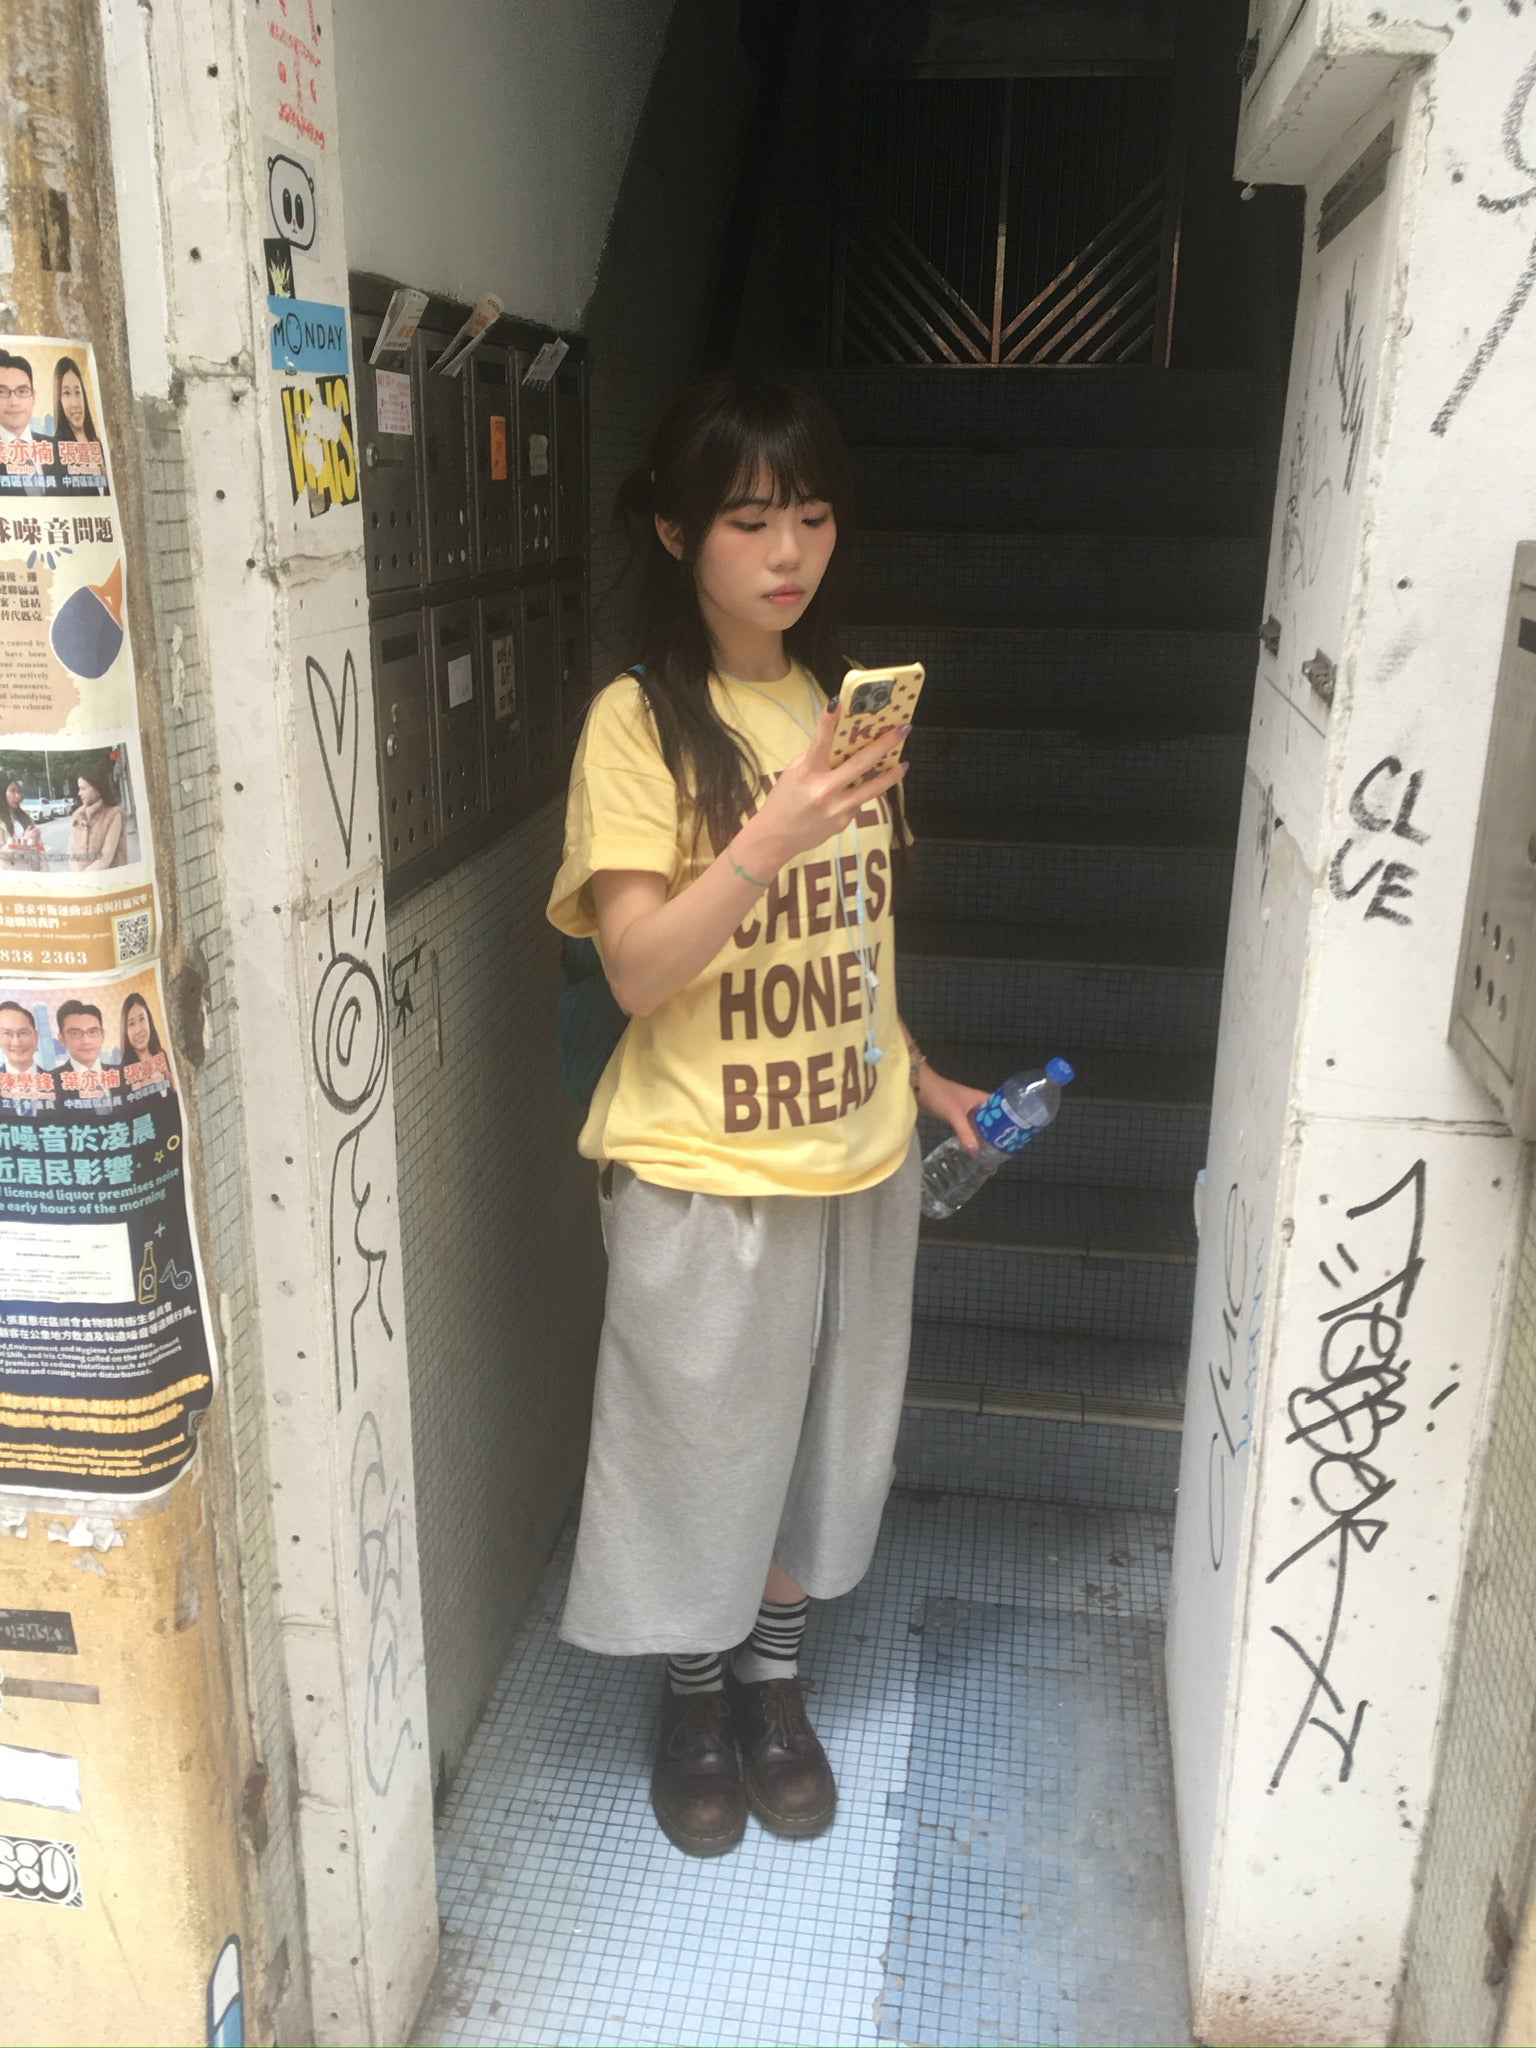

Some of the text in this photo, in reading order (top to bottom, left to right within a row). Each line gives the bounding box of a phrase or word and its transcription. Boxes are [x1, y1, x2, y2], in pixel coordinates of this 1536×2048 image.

[273, 312, 343, 355] MONDAY
[41, 950, 88, 964] 2363
[60, 1068, 120, 1090] 葉亦楠
[4, 1167, 180, 1202] licensed liquor premises noise
[7, 1187, 167, 1215] early hours of the morning
